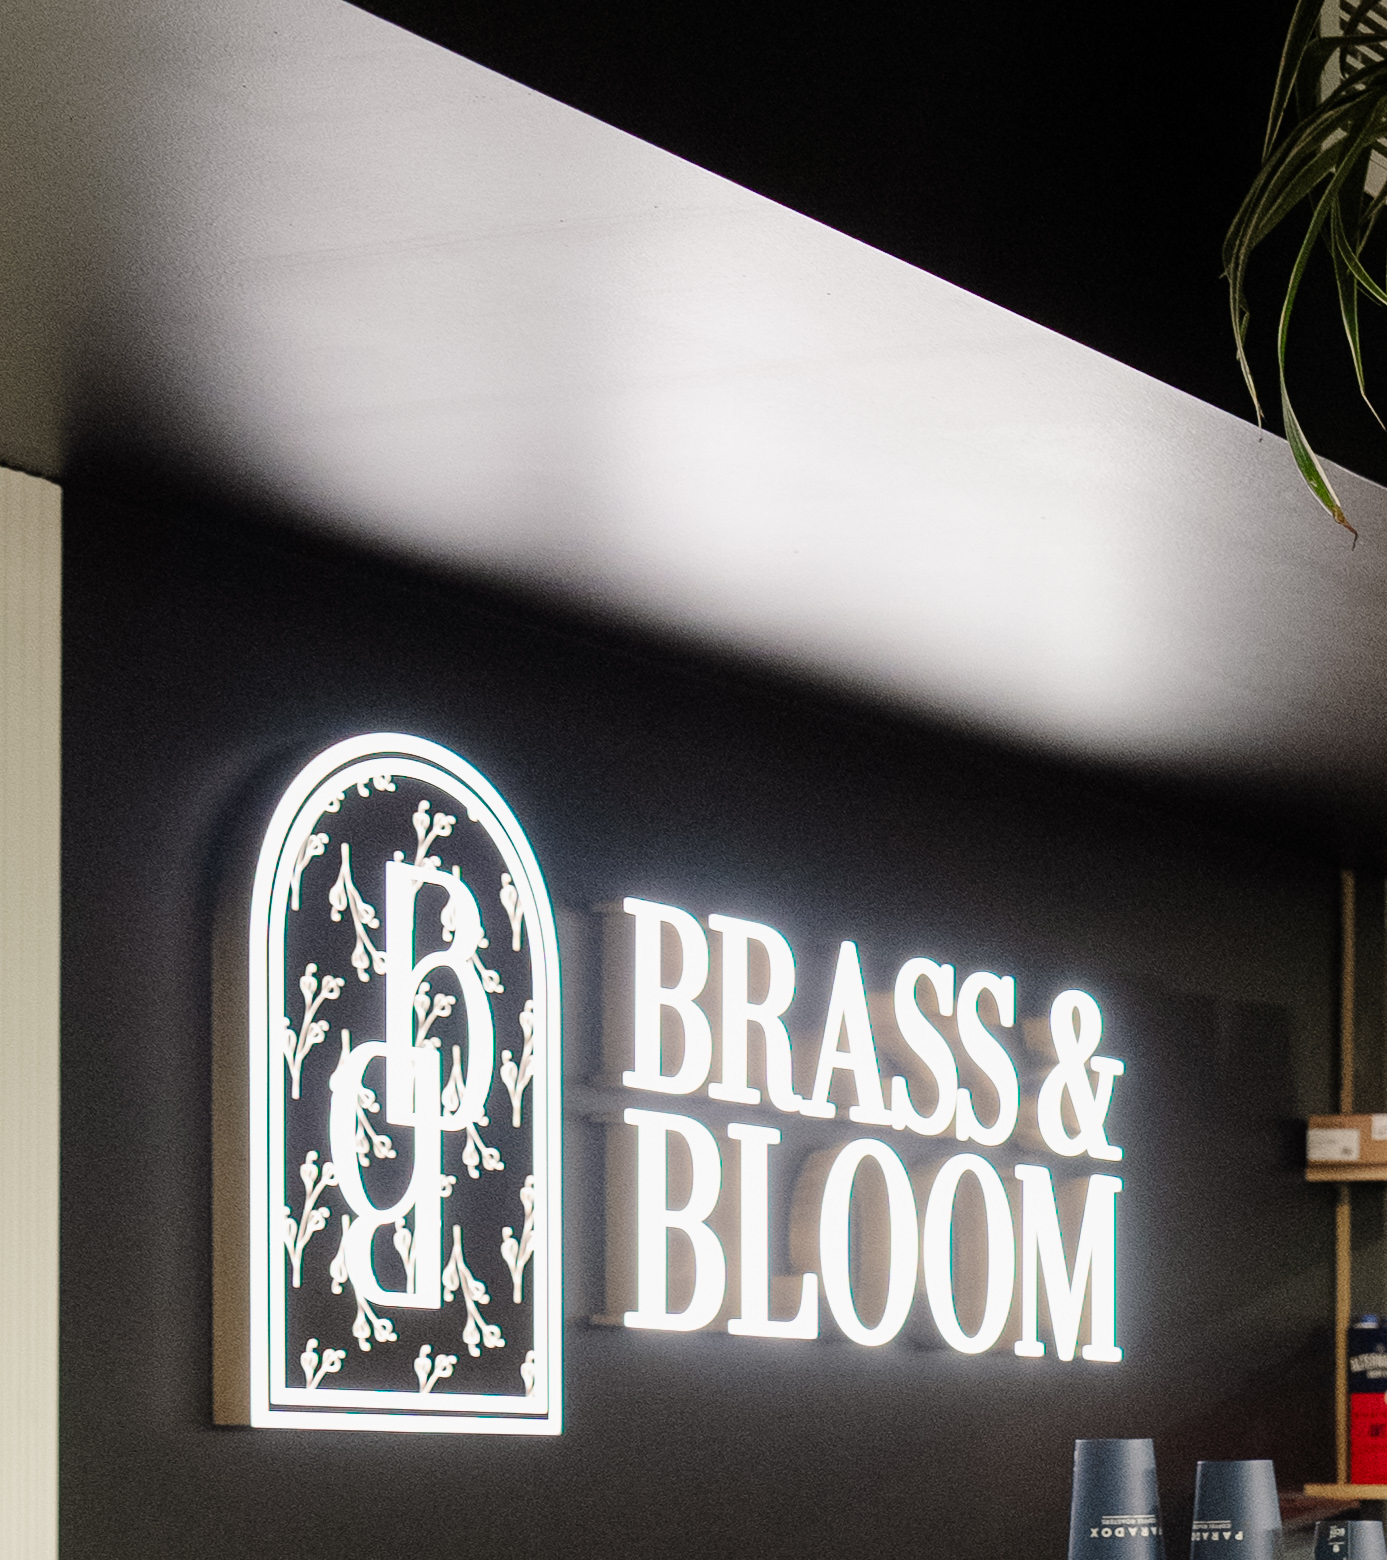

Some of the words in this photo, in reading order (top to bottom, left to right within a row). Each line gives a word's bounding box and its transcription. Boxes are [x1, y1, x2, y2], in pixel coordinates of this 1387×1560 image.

[622, 896, 1021, 1146] BRASS
[1037, 988, 1124, 1162] &
[622, 1107, 1124, 1362] BLOOM
